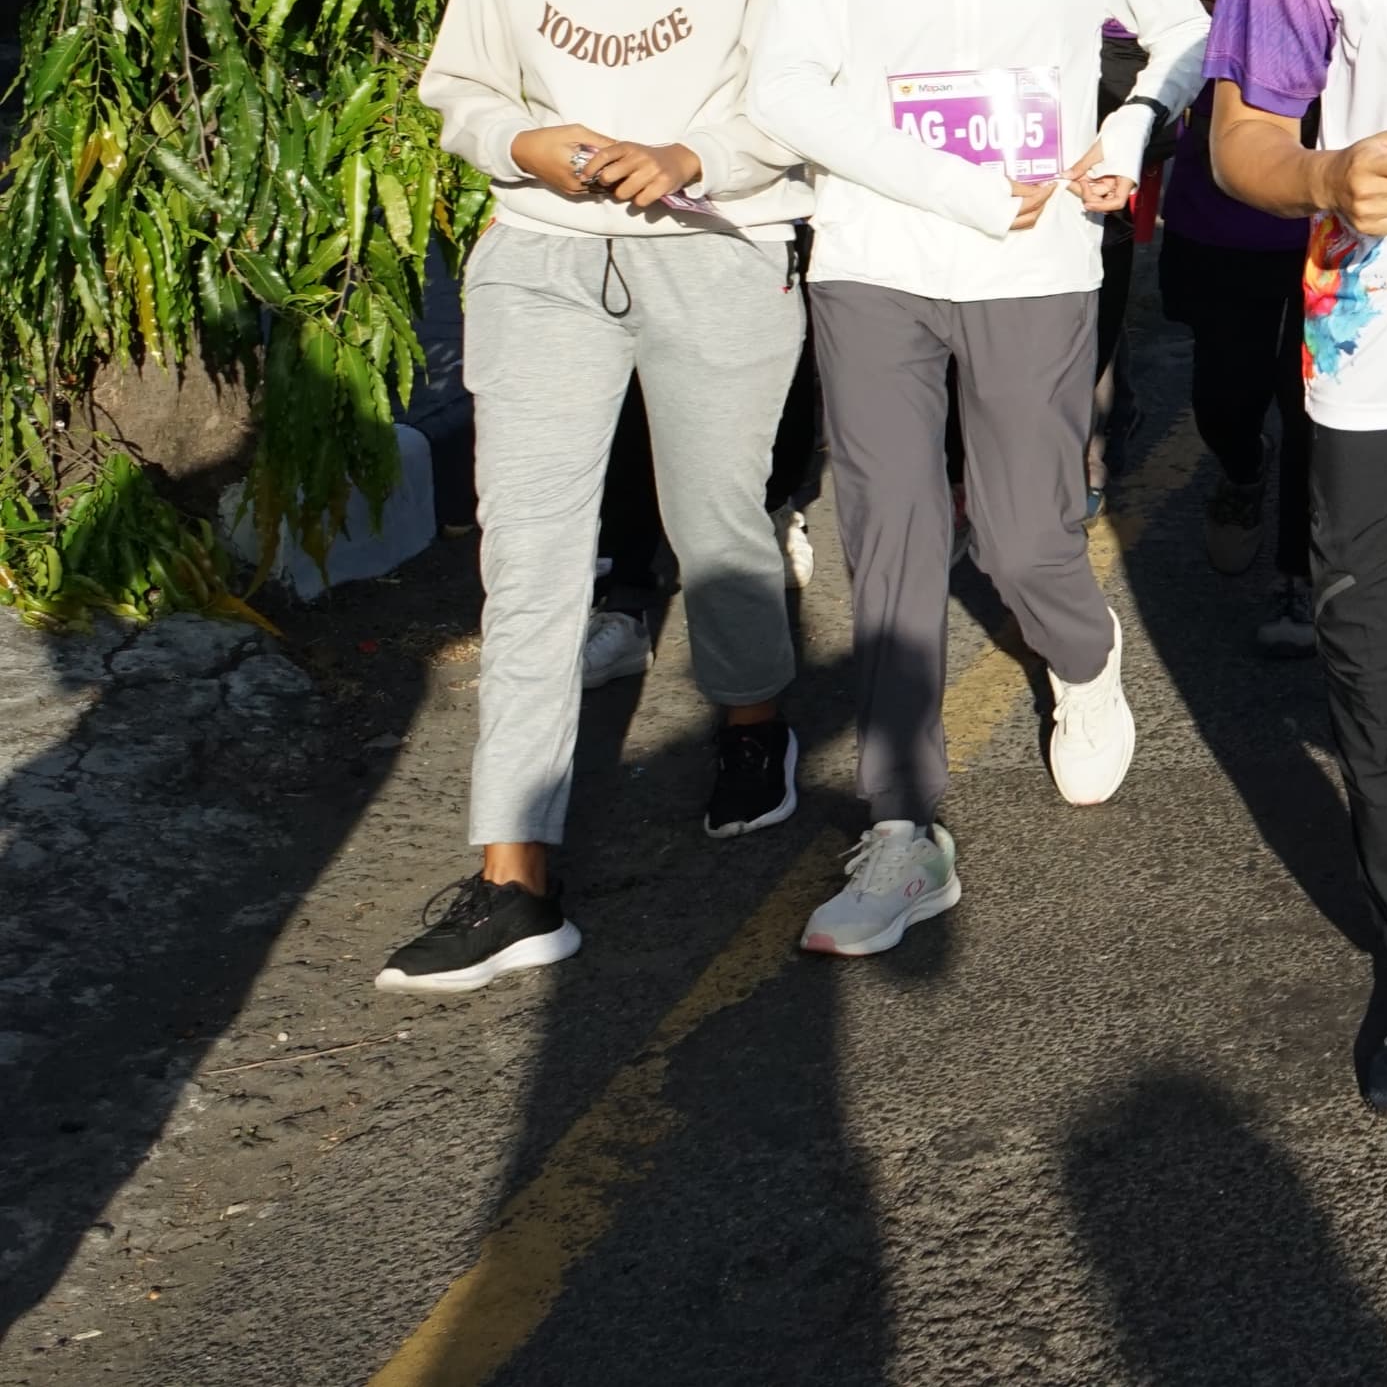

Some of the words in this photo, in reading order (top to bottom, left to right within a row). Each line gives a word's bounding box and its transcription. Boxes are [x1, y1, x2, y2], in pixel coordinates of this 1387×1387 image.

[537, 1, 693, 68] YOZIOFACE
[918, 83, 953, 94] Mapan
[901, 111, 946, 149] AG
